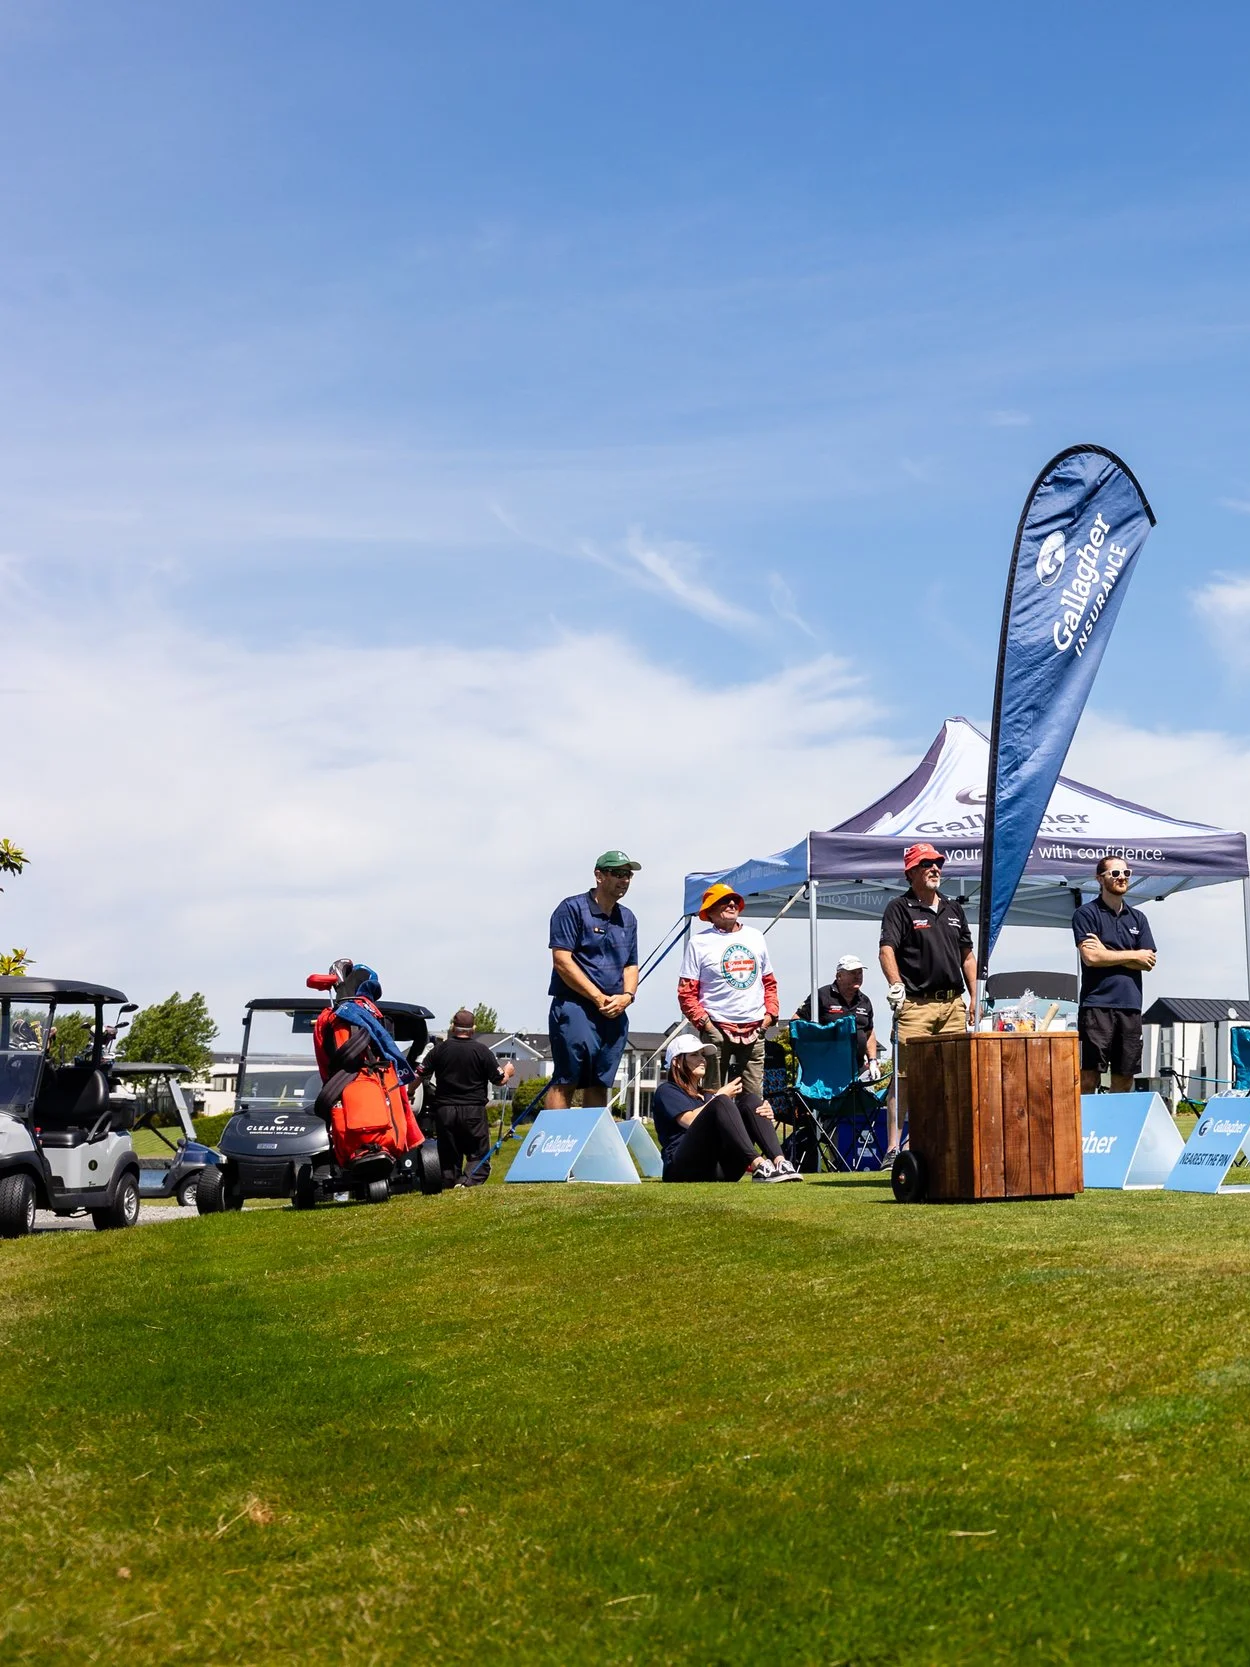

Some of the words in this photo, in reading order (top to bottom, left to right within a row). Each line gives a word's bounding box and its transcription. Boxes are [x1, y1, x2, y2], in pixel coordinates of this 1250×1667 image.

[1053, 512, 1111, 651] Gallagher
[1075, 543, 1127, 657] INSURANCE
[945, 848, 981, 863] your
[1038, 844, 1072, 859] with
[1077, 845, 1166, 861] confidence.
[1213, 1119, 1247, 1136] Gallagher
[541, 1134, 578, 1157] Gallagher
[1178, 1152, 1208, 1166] NEAREST
[1204, 1153, 1220, 1167] THE
[1216, 1153, 1232, 1168] PIN
